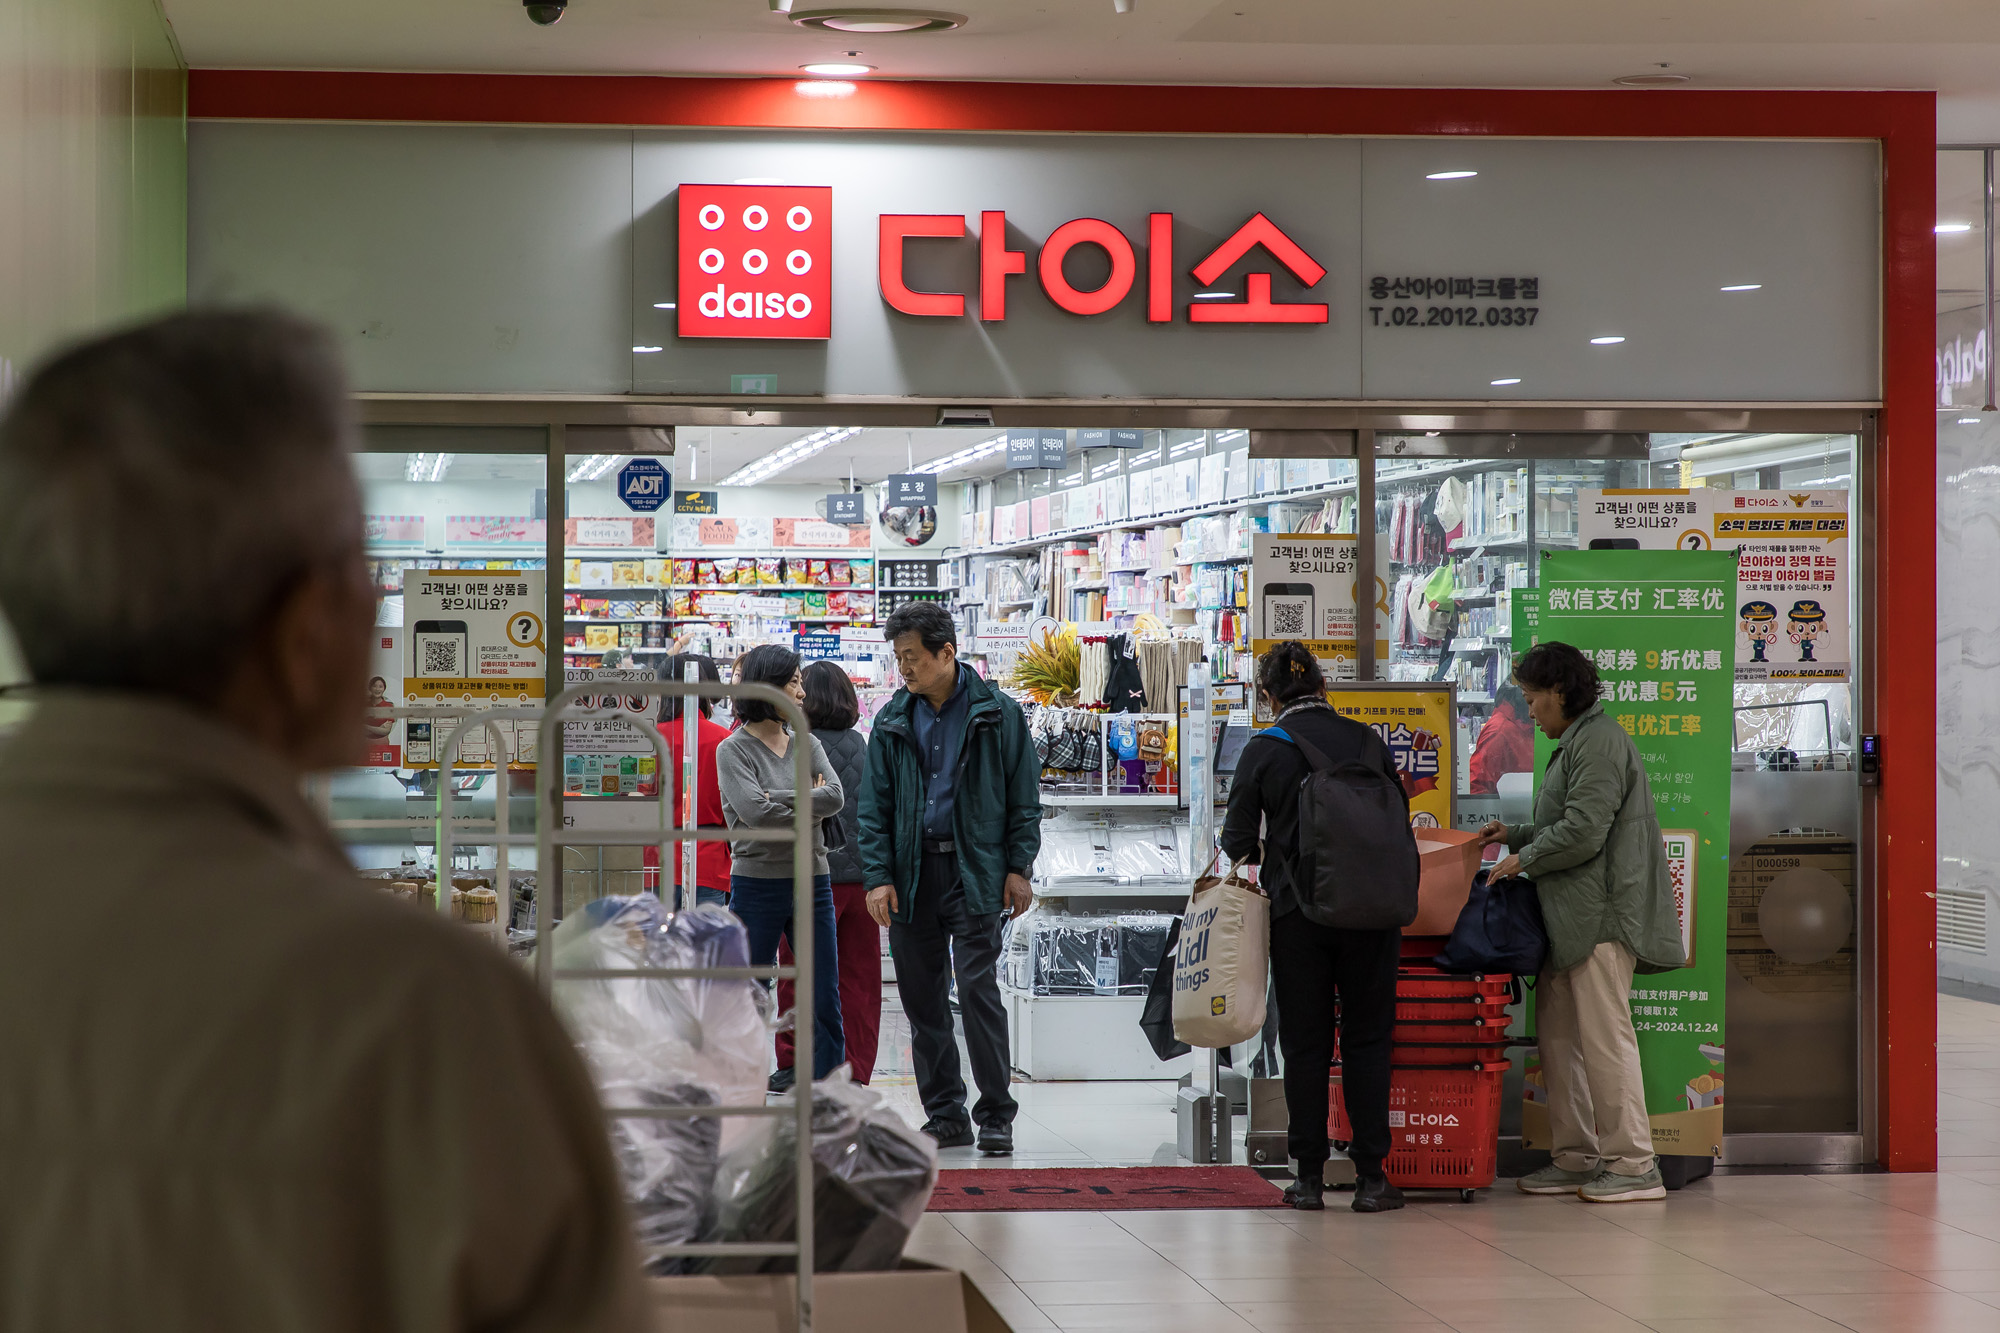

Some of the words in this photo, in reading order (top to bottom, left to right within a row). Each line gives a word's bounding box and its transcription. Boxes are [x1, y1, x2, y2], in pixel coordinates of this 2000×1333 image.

[878, 210, 1329, 324] 다이소
[1369, 276, 1539, 299] 용산아이파크몰점
[698, 284, 812, 319] daiso
[1369, 307, 1539, 327] T.02.2012.0337
[1117, 431, 1136, 439] FASHION
[1010, 437, 1035, 451] 인테리어
[1042, 437, 1064, 451] 인테리어
[1012, 454, 1032, 462] INTERIOR
[1044, 454, 1061, 462] INTERIOR
[626, 475, 663, 495] ADT
[1594, 502, 1633, 514] 고객님!
[1637, 502, 1658, 514] 어떤
[1663, 502, 1697, 514] 상품을
[1747, 498, 1779, 507] 다이소
[1614, 516, 1678, 528] 찾으시나요?
[1719, 520, 1745, 531] 소액
[1747, 520, 1786, 531] 범죄도
[1788, 520, 1814, 531] 처벌
[1816, 520, 1846, 531] 대상!
[1270, 546, 1308, 559] 고객님!
[1312, 546, 1334, 559] 어떤
[1289, 560, 1354, 574] 찾으시나요?
[1737, 556, 1786, 567] 년이하의
[1789, 556, 1811, 567] 징역
[1814, 556, 1836, 567] 또는
[1776, 570, 1810, 582] 이하의
[1814, 570, 1836, 582] 벌금
[420, 582, 460, 596] 고객님!
[465, 582, 488, 596] 어떤
[492, 582, 528, 596] 상품을
[440, 598, 508, 610] 찾으시나요?
[1548, 588, 1643, 611] 微信支付
[1652, 588, 1725, 611] 汇率优
[986, 626, 1026, 635] 시즌/시리즈
[1645, 649, 1722, 671] 9折优惠
[621, 672, 654, 682] 22:00
[1770, 669, 1796, 678] 100%
[1598, 680, 1698, 702] 高优惠5元
[1338, 707, 1361, 716] 선물용
[1364, 707, 1388, 716] 기프트
[1390, 707, 1406, 716] 카드
[1408, 707, 1426, 716] 판매!
[592, 721, 632, 732] 설치안내
[1616, 714, 1702, 736] 超优汇率
[1394, 750, 1438, 772] 카드
[1674, 772, 1694, 784] 할인
[1652, 792, 1670, 804] 사용
[1672, 792, 1692, 804] 가능
[1756, 858, 1800, 868] 0000598
[1181, 912, 1195, 932] All
[1196, 906, 1218, 929] my
[1176, 928, 1210, 970] Lidl
[1098, 978, 1106, 986] M
[1176, 968, 1210, 992] things
[1631, 1006, 1678, 1016] 可领取1次
[1410, 1113, 1460, 1126] 다이소
[1406, 1134, 1444, 1144] 매장용
